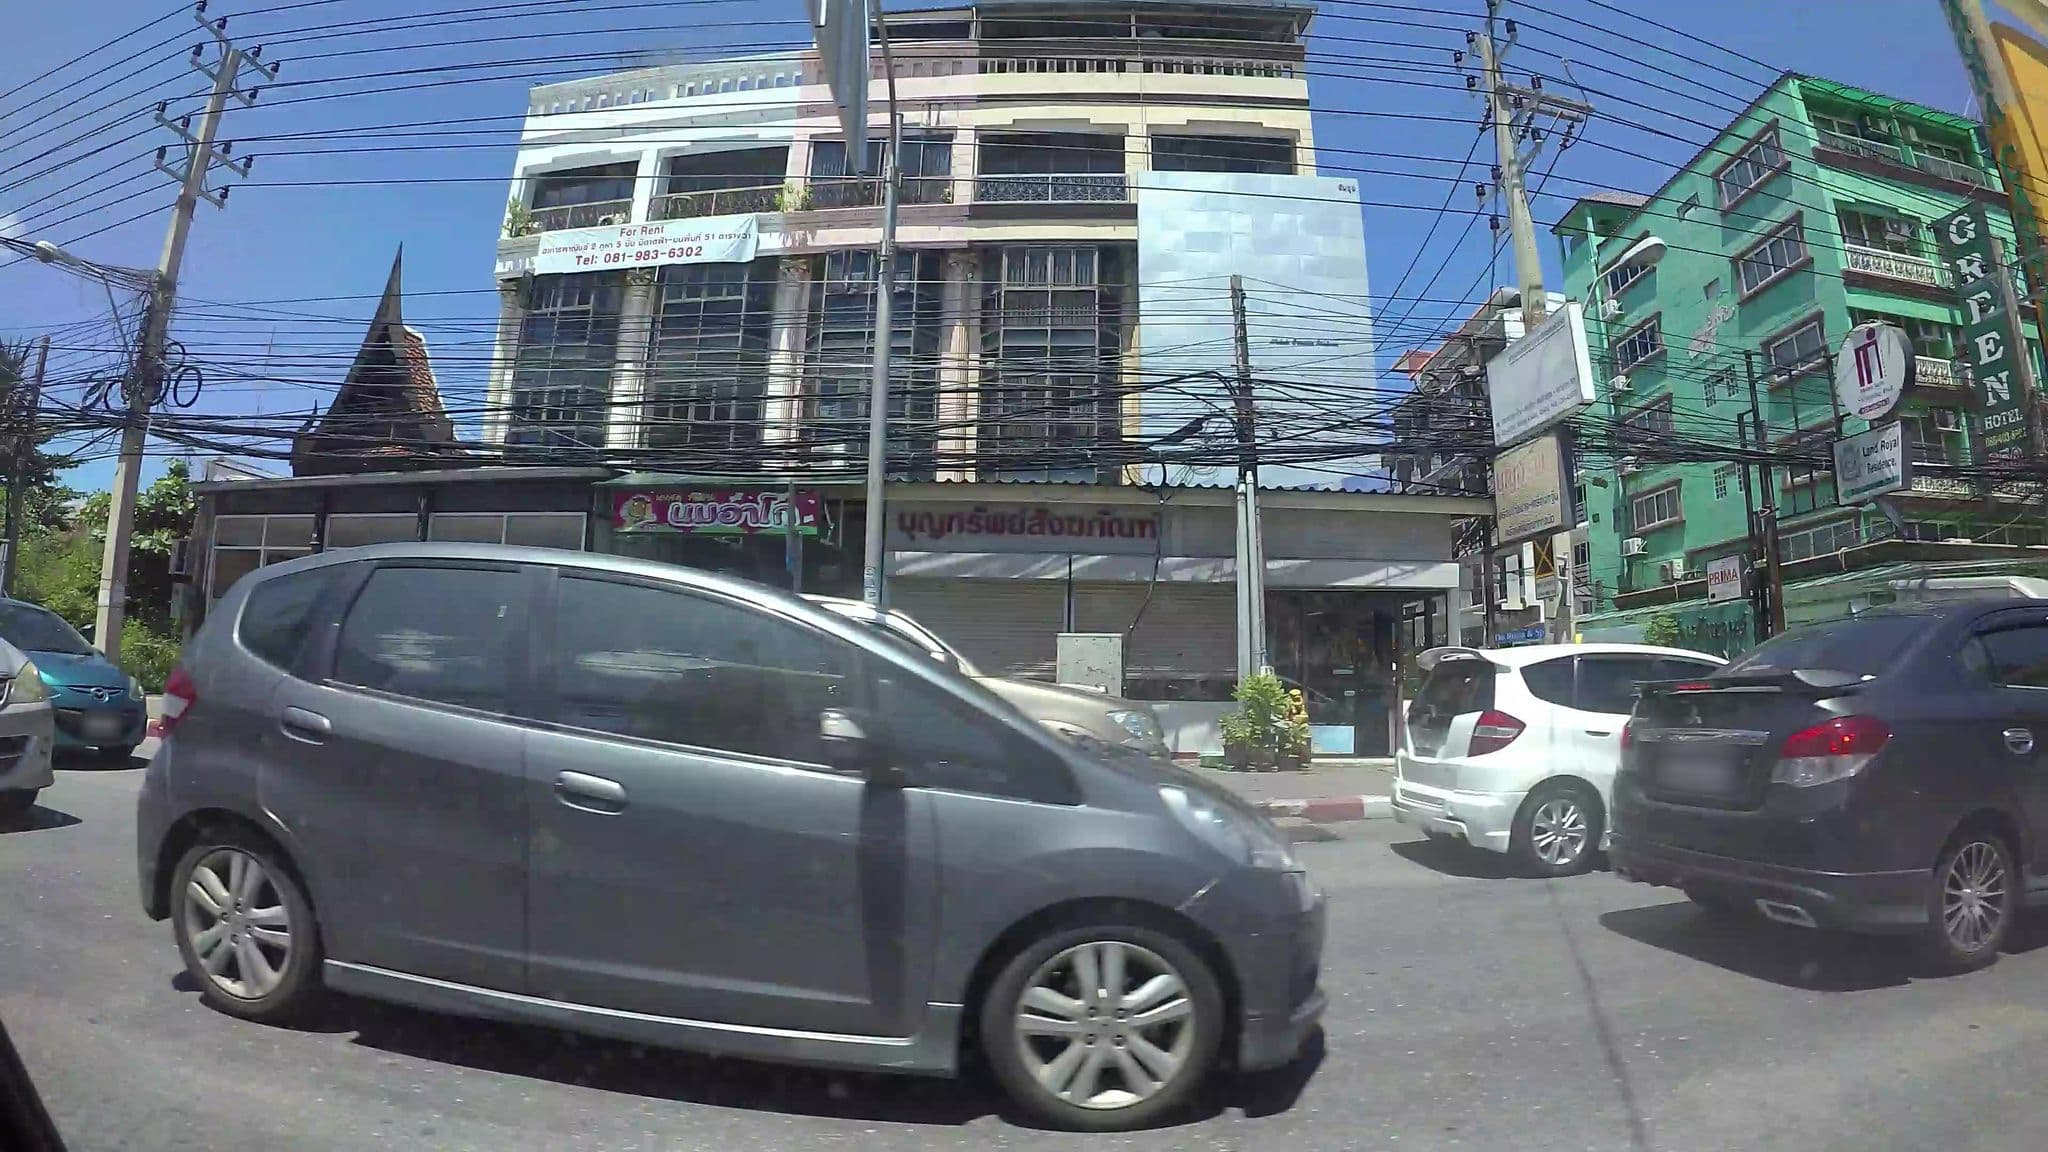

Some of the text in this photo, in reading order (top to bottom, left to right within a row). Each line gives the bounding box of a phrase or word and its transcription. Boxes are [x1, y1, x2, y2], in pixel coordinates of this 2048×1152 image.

[619, 226, 665, 237] For Rent
[615, 240, 622, 249] 5
[575, 246, 703, 266] Tel: 081-983-6302
[1983, 407, 2024, 430] HOTEL
[1862, 441, 1879, 457] Land
[1708, 567, 1739, 586] PRIMA
